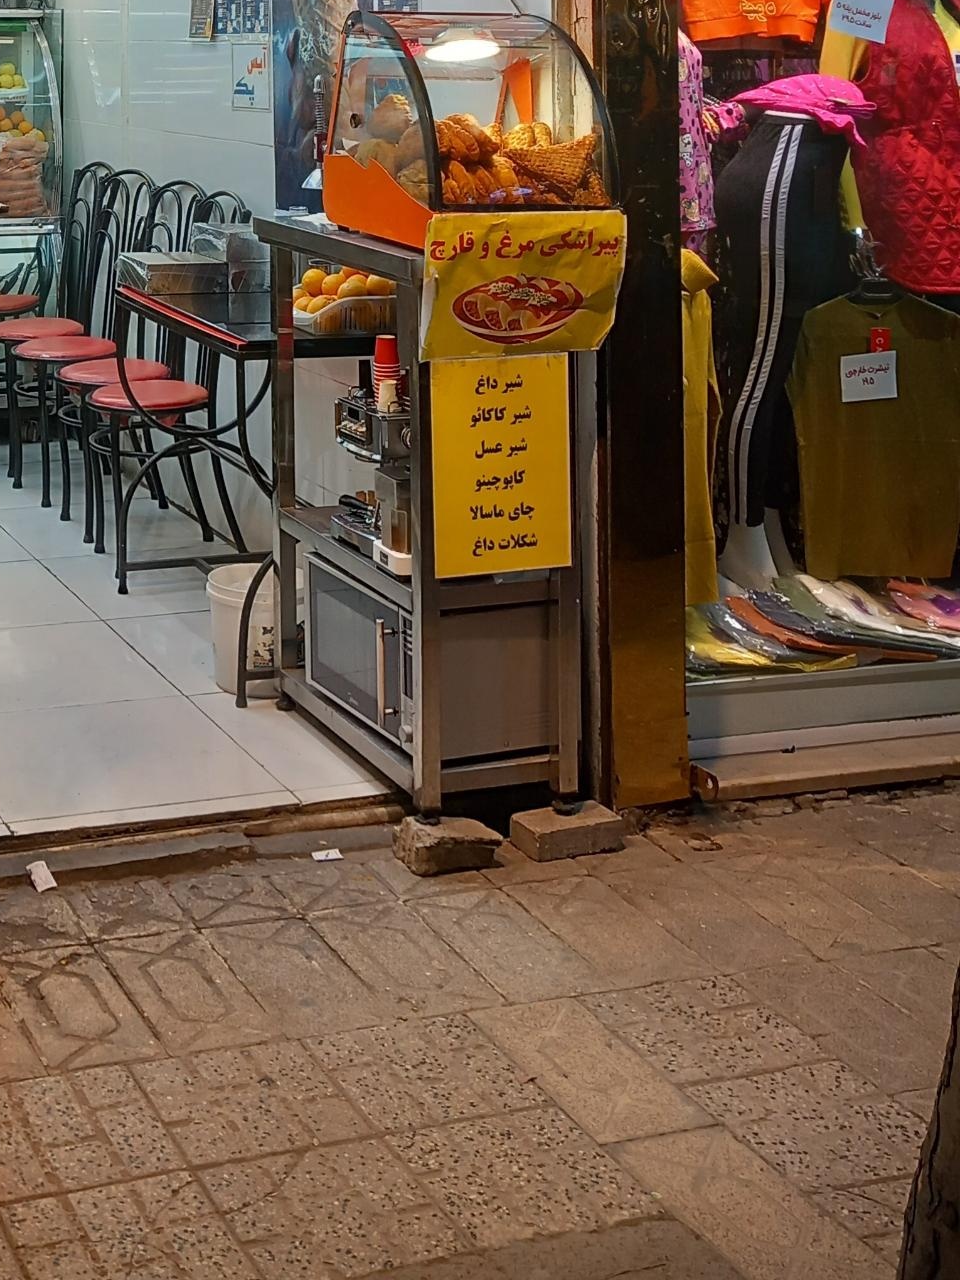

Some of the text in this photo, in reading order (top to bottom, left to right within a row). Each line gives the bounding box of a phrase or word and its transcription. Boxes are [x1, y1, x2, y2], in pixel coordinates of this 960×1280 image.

[429, 228, 620, 262] پیراشکی مرغ و قارچ
[474, 374, 523, 395] شیر داغ
[469, 405, 532, 428] شیر کاکائو
[474, 438, 528, 459] شیر عسل
[469, 502, 536, 521] چای ماسالا
[472, 533, 538, 557] شکلات داغ
